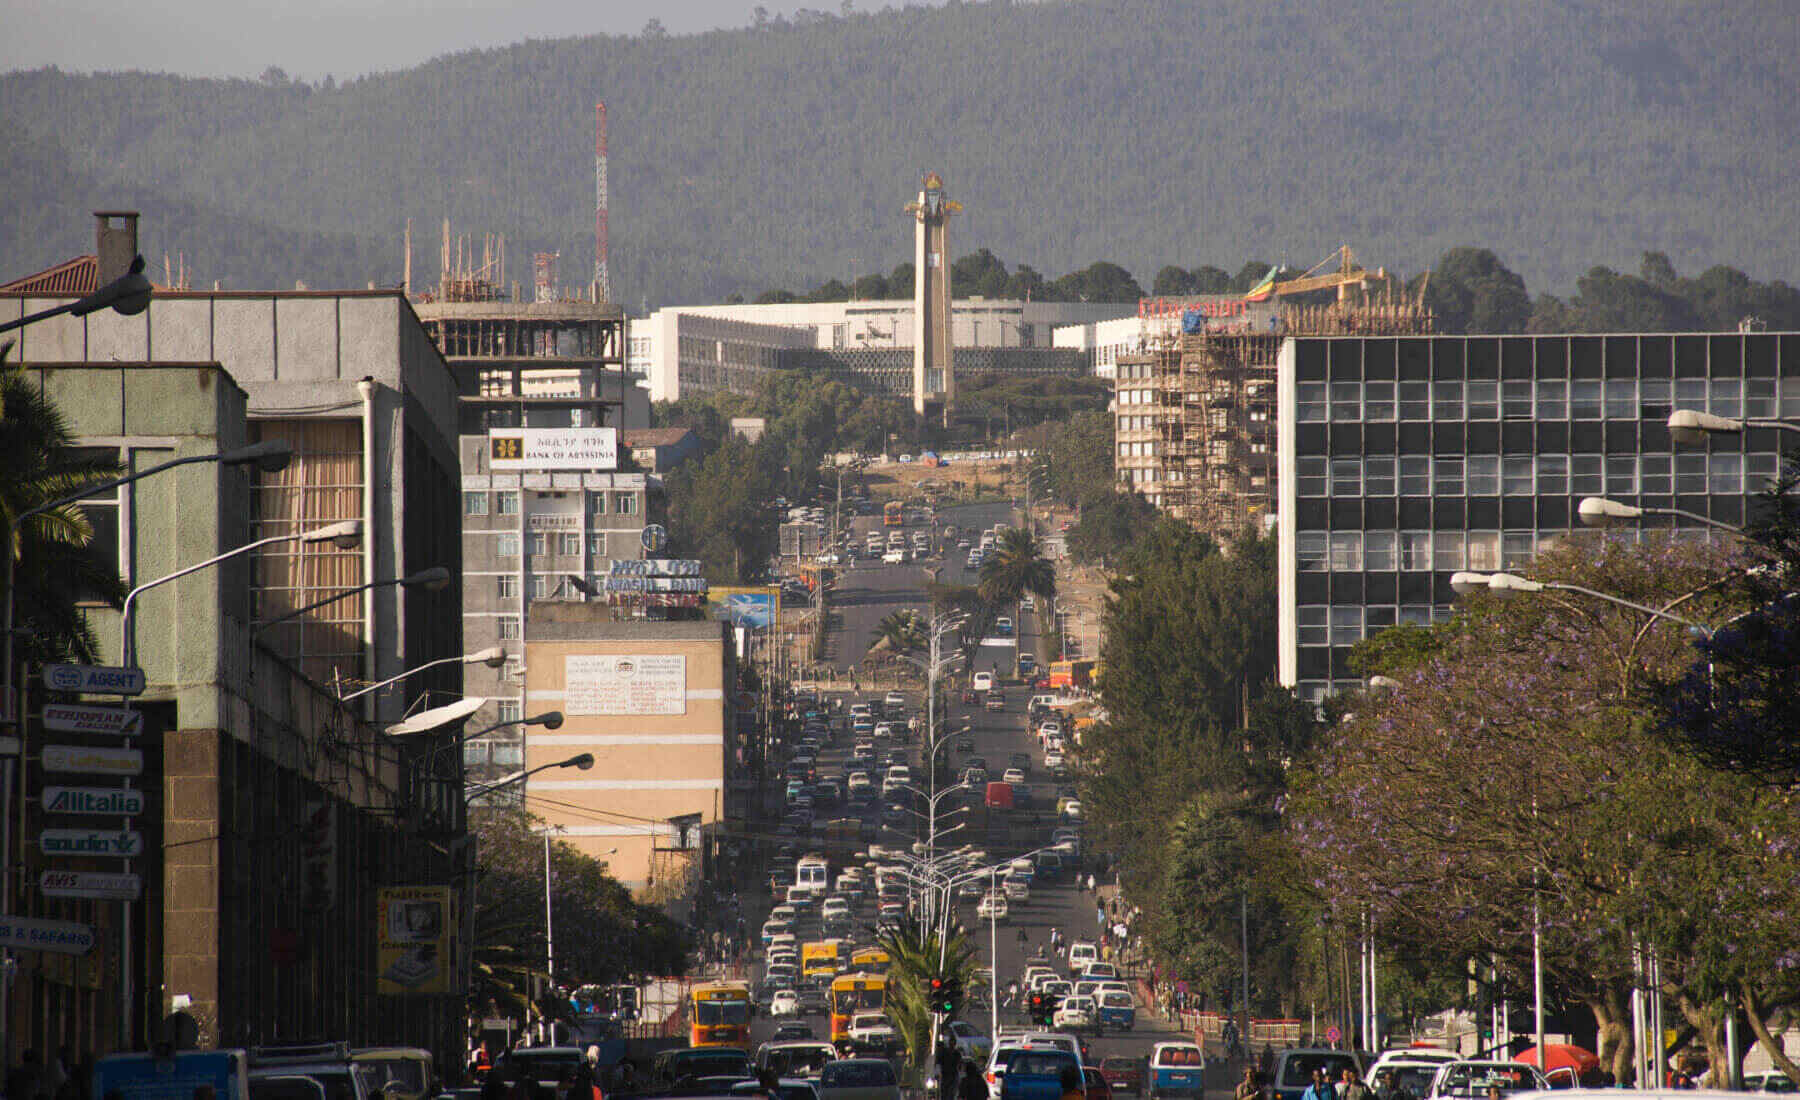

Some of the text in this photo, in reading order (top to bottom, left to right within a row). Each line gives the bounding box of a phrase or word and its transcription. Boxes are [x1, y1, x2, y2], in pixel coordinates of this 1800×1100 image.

[526, 451, 615, 459] BANK OF ABYSSINIA
[87, 671, 137, 688] AGENT
[48, 792, 140, 812] Alitalia
